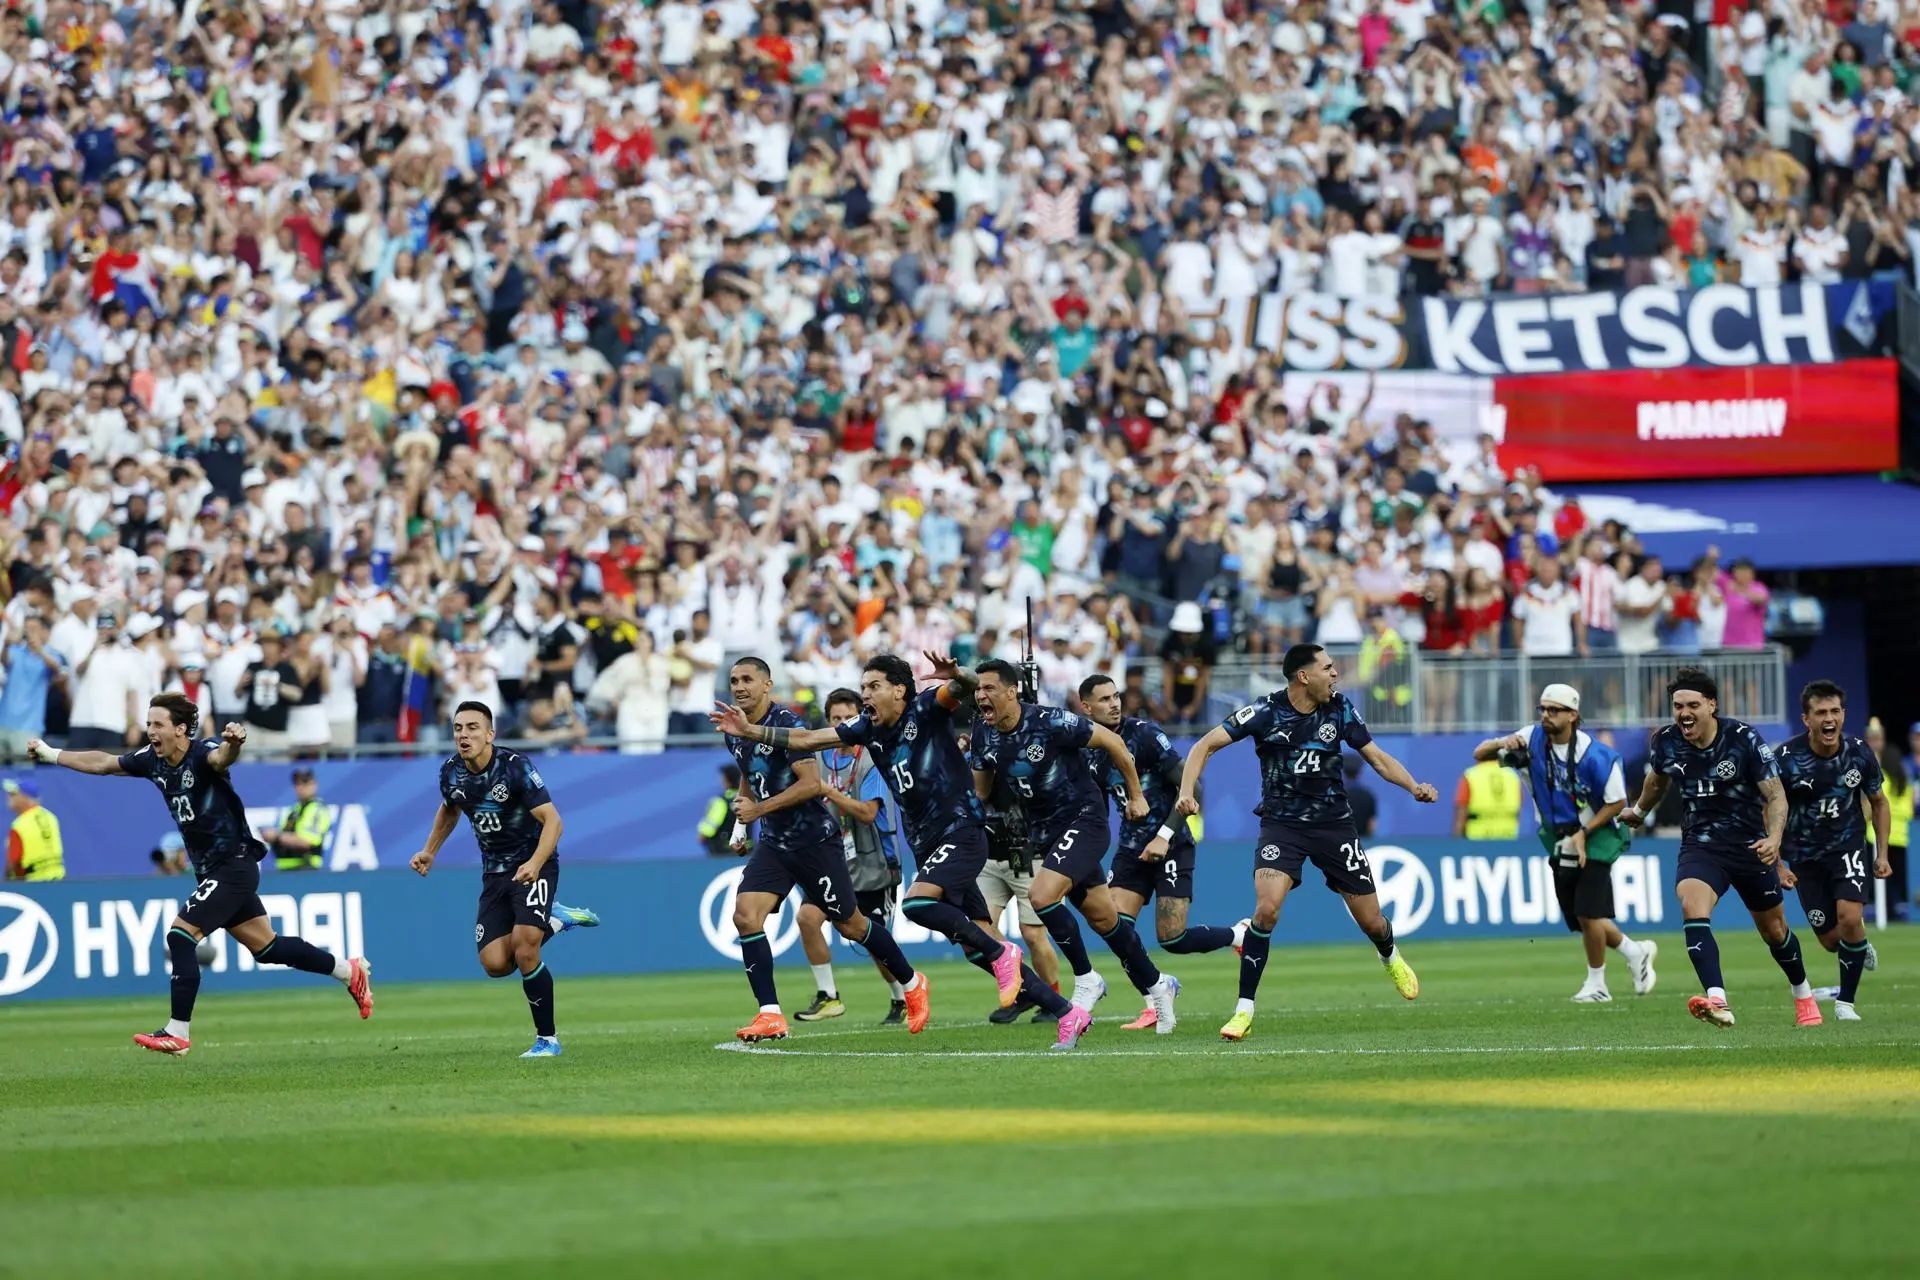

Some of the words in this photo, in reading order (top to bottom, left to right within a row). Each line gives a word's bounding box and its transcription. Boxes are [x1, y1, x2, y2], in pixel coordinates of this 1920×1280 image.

[1422, 281, 1834, 374] KETSCH
[1637, 399, 1787, 440] PARAGUAY
[1294, 750, 1321, 774] 24
[755, 772, 770, 799] 2
[892, 759, 914, 794] 15
[1017, 776, 1034, 798] 5
[1697, 779, 1717, 797] 11
[172, 795, 195, 822] 23
[1114, 784, 1129, 807] 9
[1816, 798, 1840, 819] 14
[474, 812, 502, 833] 20
[1058, 829, 1079, 850] 5
[1340, 839, 1368, 872] 24
[1841, 850, 1866, 878] 14
[524, 879, 548, 907] 20
[818, 875, 837, 903] 2
[1440, 856, 1663, 924] HYUAI
[72, 891, 363, 979] HYDAI
